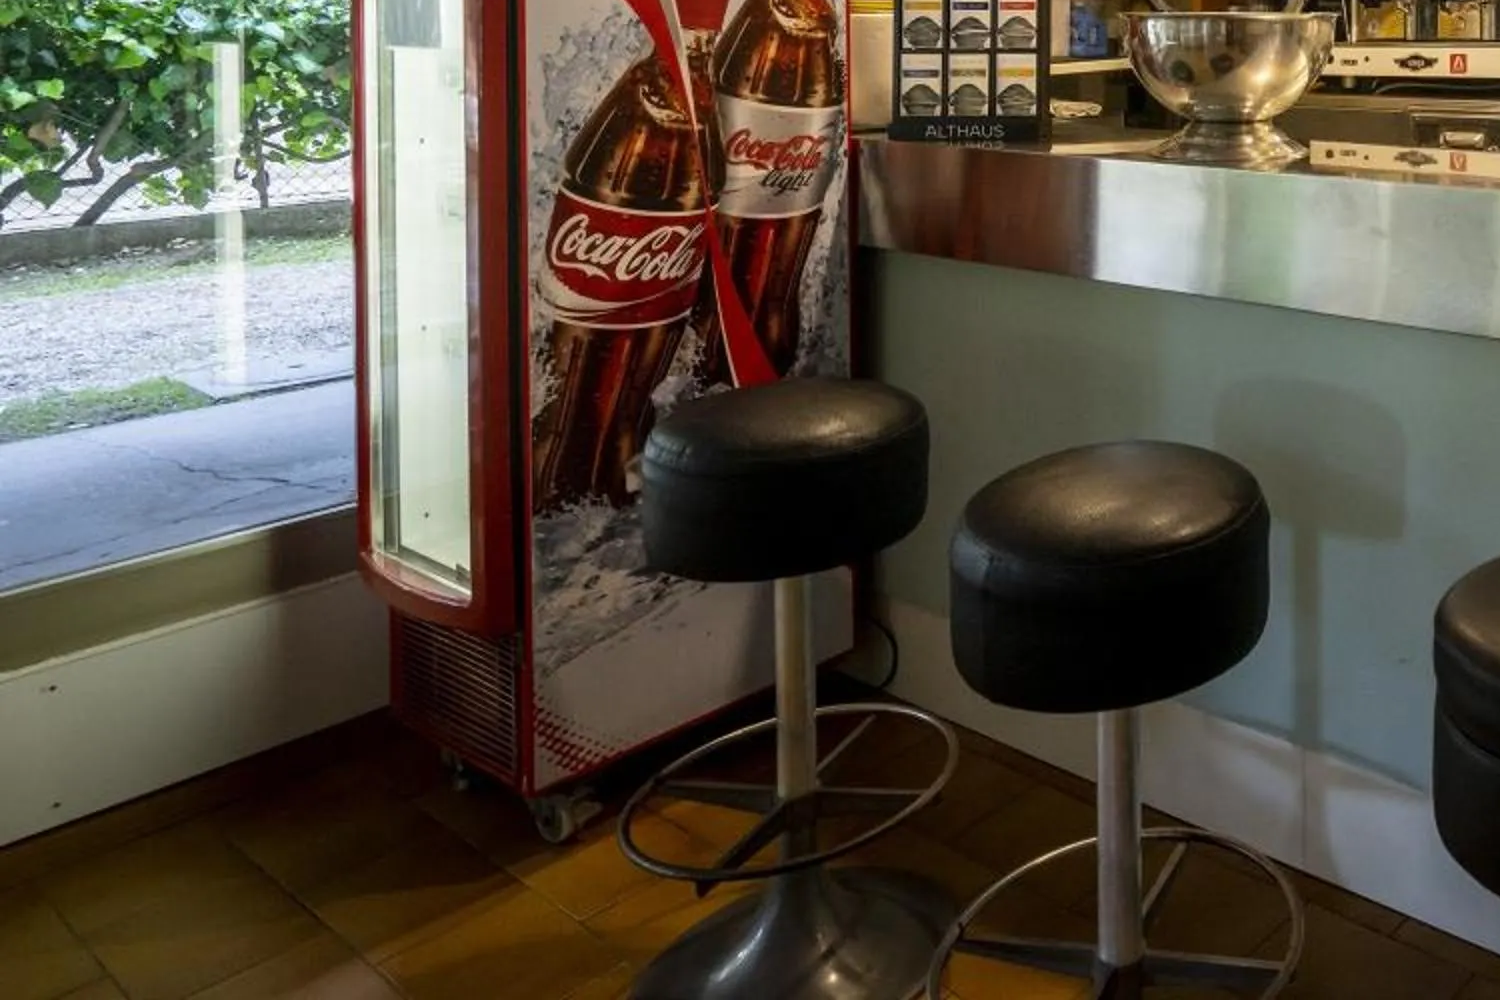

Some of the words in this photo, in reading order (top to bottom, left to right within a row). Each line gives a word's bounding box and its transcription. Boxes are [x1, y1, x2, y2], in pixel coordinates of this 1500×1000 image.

[925, 124, 1006, 139] ALTHAUS
[761, 167, 814, 197] light
[551, 213, 705, 282] Coca-Cola
